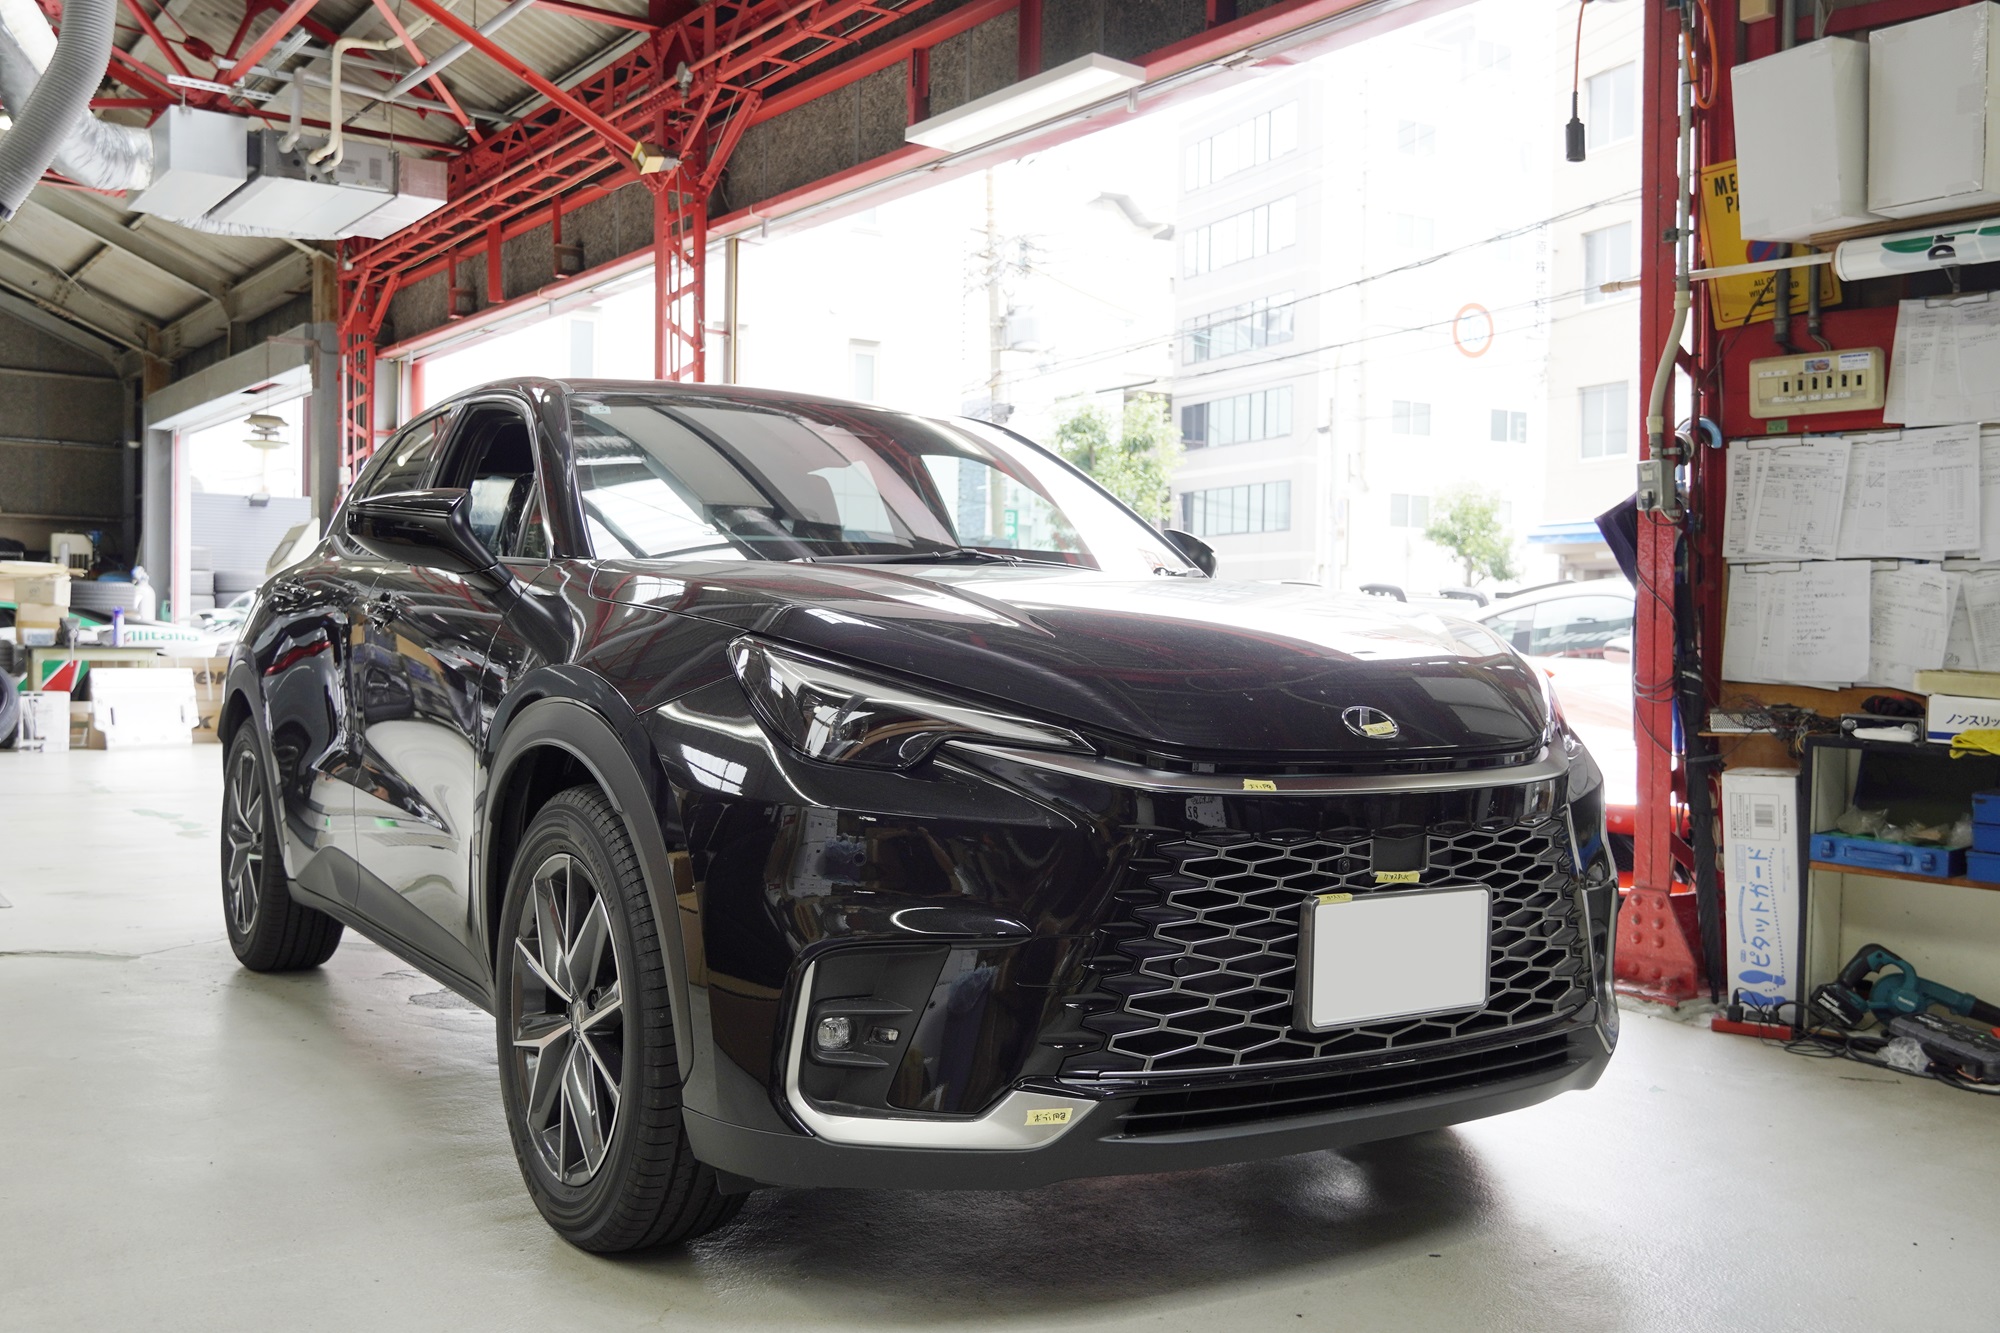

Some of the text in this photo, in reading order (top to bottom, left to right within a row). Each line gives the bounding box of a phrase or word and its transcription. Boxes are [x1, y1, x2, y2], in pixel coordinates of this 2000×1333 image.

[1753, 278, 1765, 287] ALL
[585, 840, 616, 917] YOKOHAMA
[1747, 846, 1771, 968] ピタットガード
